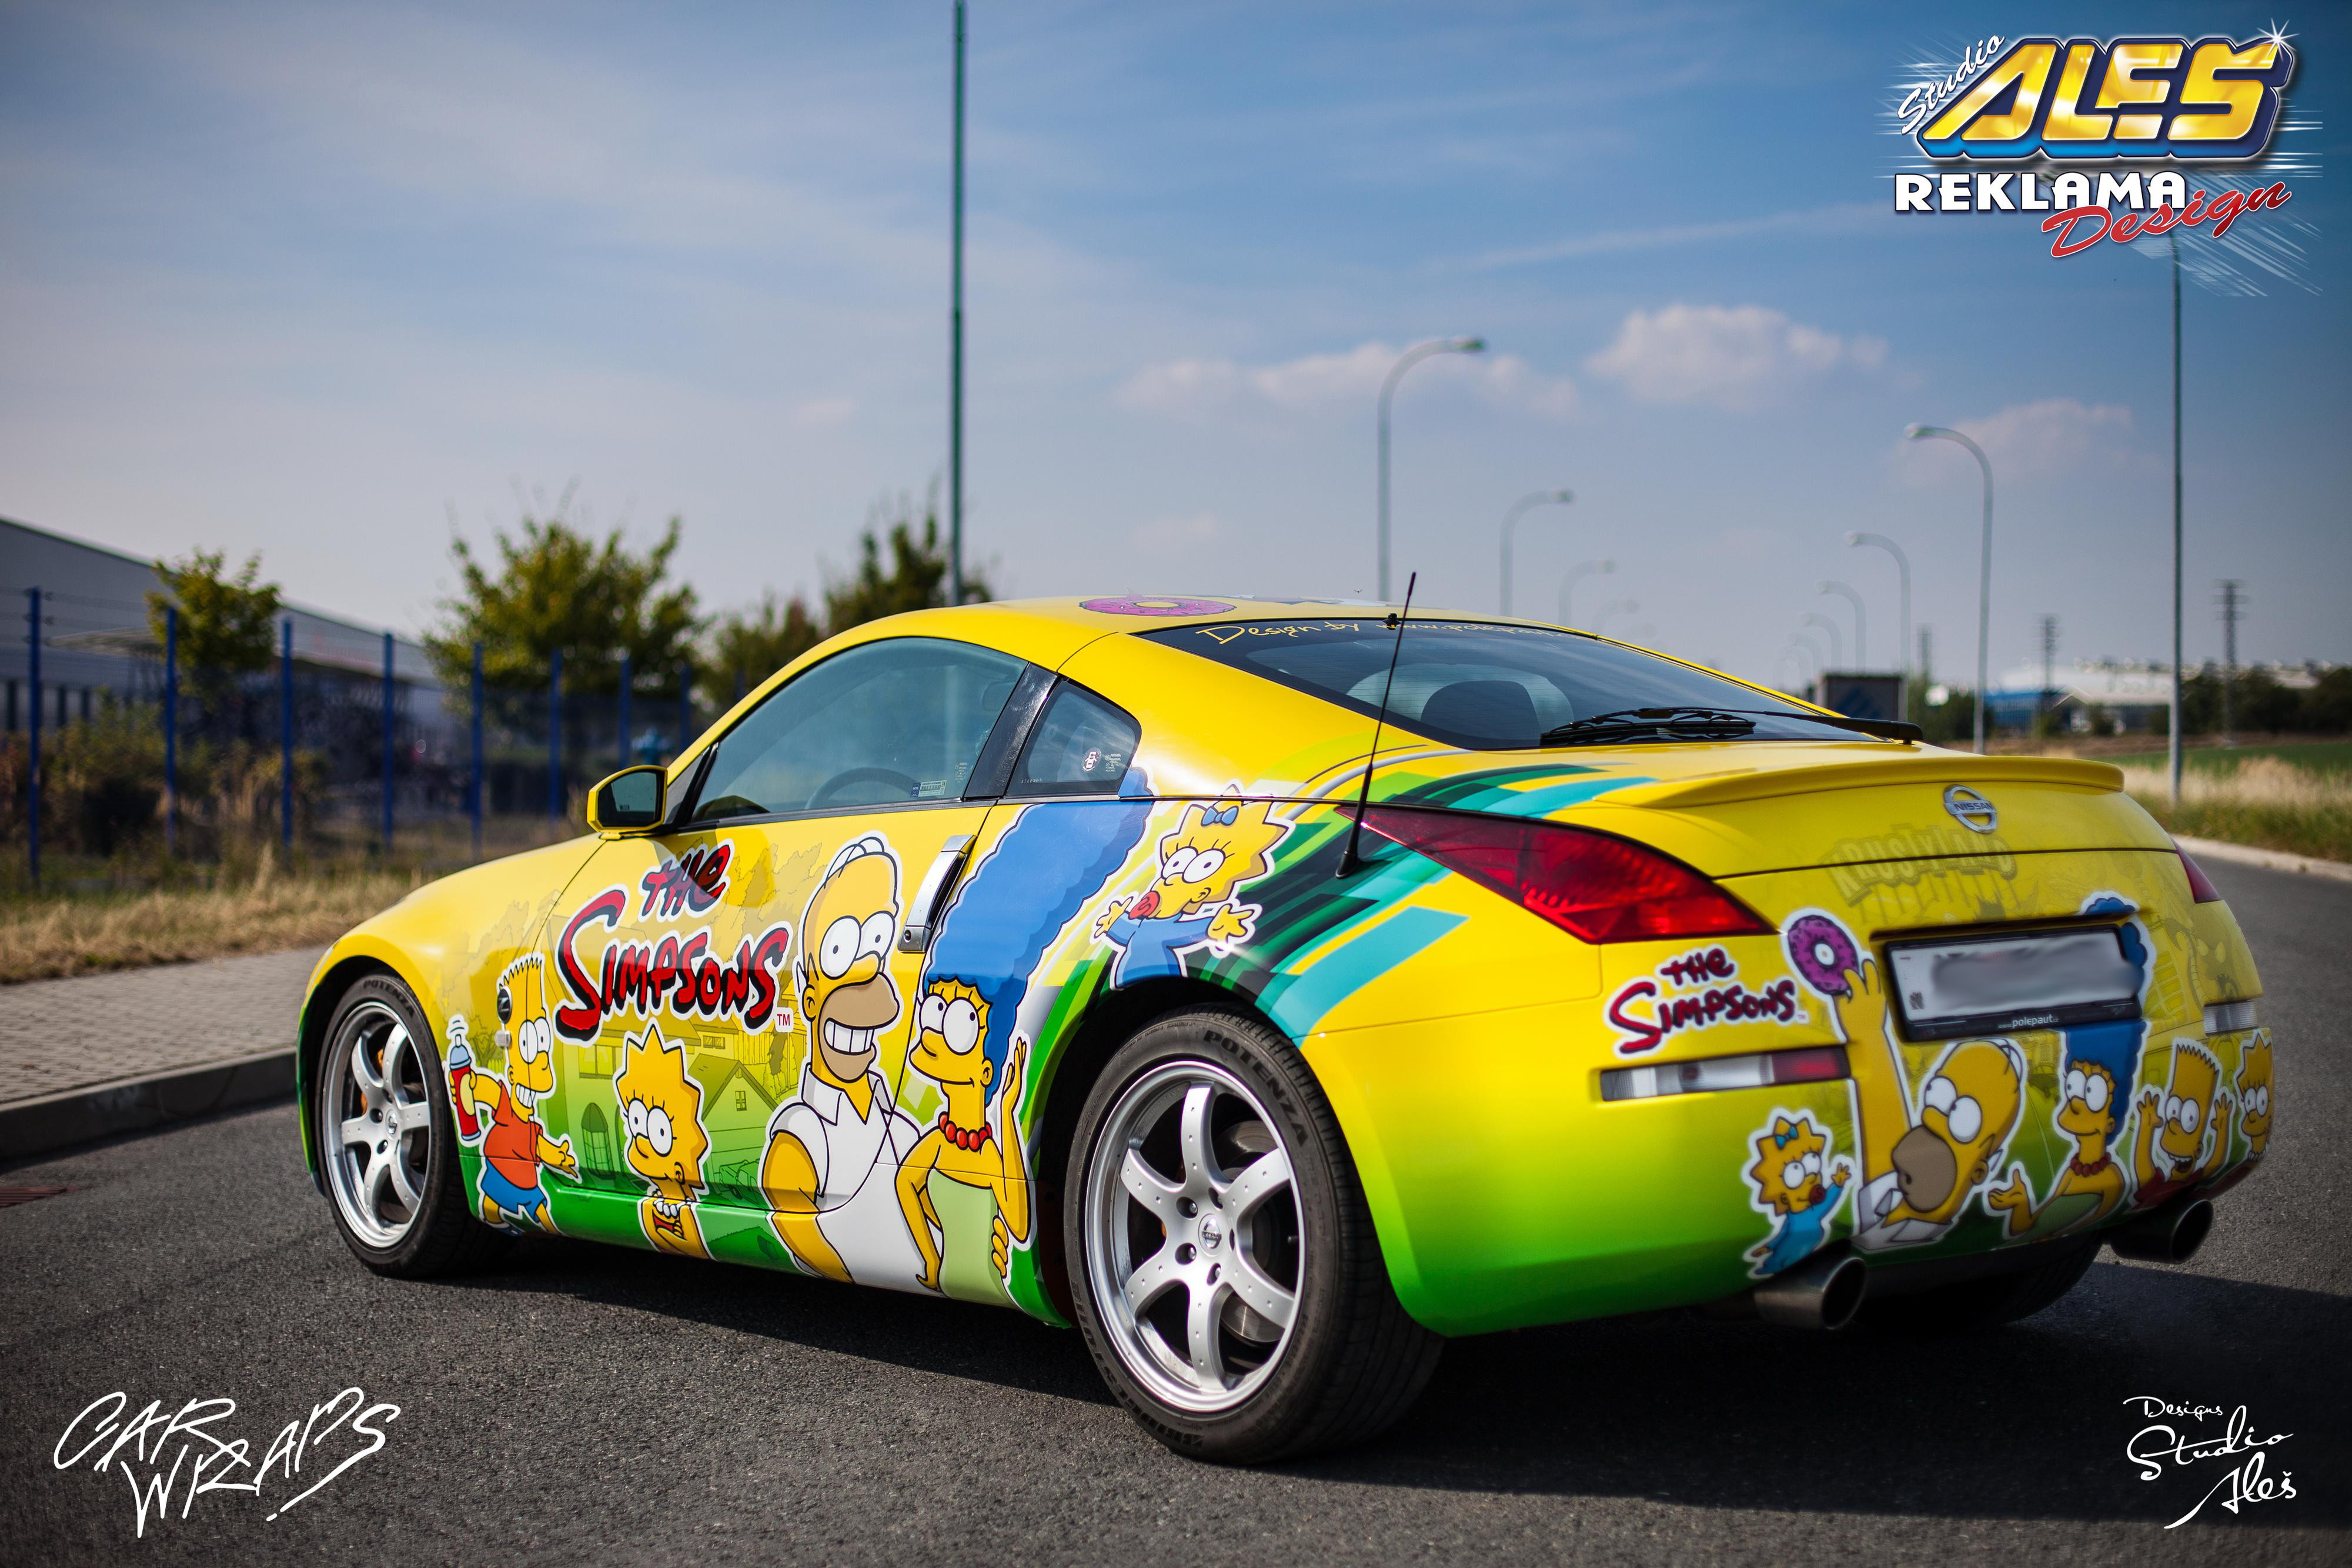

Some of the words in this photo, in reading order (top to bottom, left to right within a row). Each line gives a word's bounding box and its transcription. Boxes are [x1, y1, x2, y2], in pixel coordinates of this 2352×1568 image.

[1195, 626, 1321, 644] Design
[1324, 621, 1359, 631] by
[1954, 803, 1995, 811] NISSAN
[363, 979, 415, 1018] POTENZA
[1203, 1029, 1308, 1147] POTENZA
